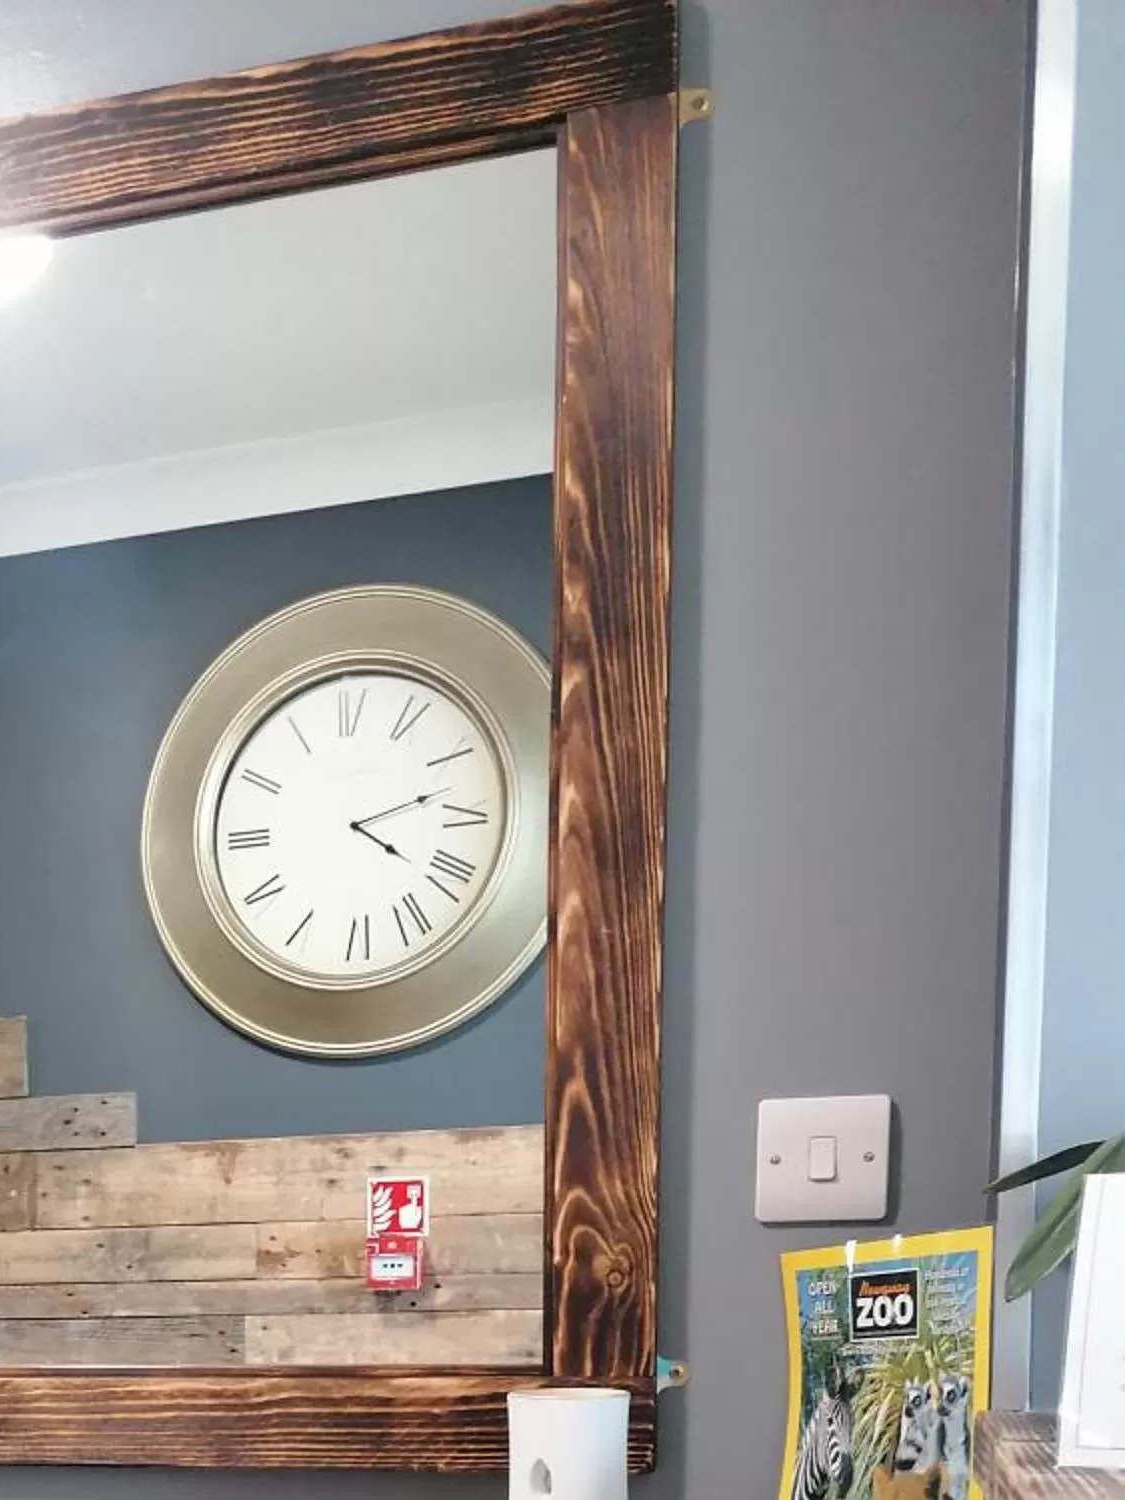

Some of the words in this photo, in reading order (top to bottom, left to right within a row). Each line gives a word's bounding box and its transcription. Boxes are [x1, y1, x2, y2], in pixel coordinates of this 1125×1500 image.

[808, 1281, 836, 1297] OPEN
[814, 1299, 834, 1314] ALL
[855, 1294, 913, 1328] ZOO
[811, 1318, 839, 1335] YEAR
